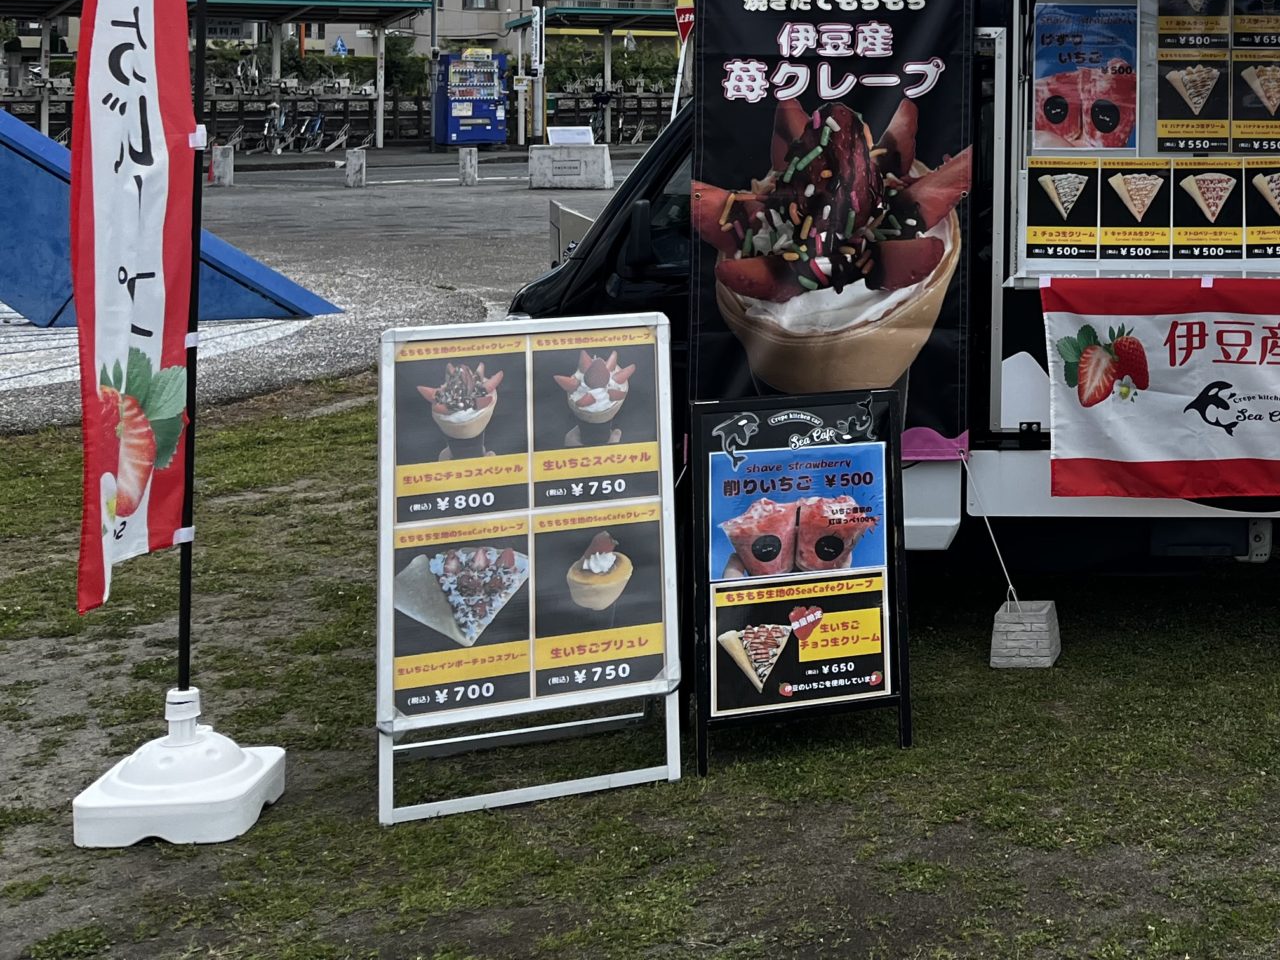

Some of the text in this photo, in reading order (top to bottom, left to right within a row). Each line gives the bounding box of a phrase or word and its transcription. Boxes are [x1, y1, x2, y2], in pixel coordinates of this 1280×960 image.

[776, 21, 894, 59] 伊豆産
[1180, 36, 1210, 45] ¥500
[721, 57, 946, 104] 苺クレープ
[1179, 140, 1210, 149] ¥550
[1040, 230, 1095, 238] チョコ生クリーム
[1047, 246, 1079, 256] ¥500
[1120, 247, 1152, 256] ¥500
[1193, 247, 1224, 256] ¥500
[1233, 395, 1256, 404] Crepe
[1235, 408, 1264, 421] Sea
[790, 428, 836, 450] Sea Cafe
[542, 451, 651, 472] 生いちごスペシャル
[746, 459, 852, 473] shave strawberry
[402, 463, 524, 485] 生いちごチョコスペシャル
[571, 478, 627, 497] ¥750
[723, 472, 874, 497] 削りいちご ¥500
[436, 492, 495, 511] ¥800
[725, 578, 874, 603] もちもち生地のSeaCafeクレープ
[820, 620, 860, 634] 生いちご
[550, 635, 649, 660] 生いちごブリュレ
[799, 632, 881, 650] チョコ生クリーム
[574, 663, 631, 684] ¥750
[822, 662, 855, 675] ¥650
[435, 682, 495, 703] ¥700
